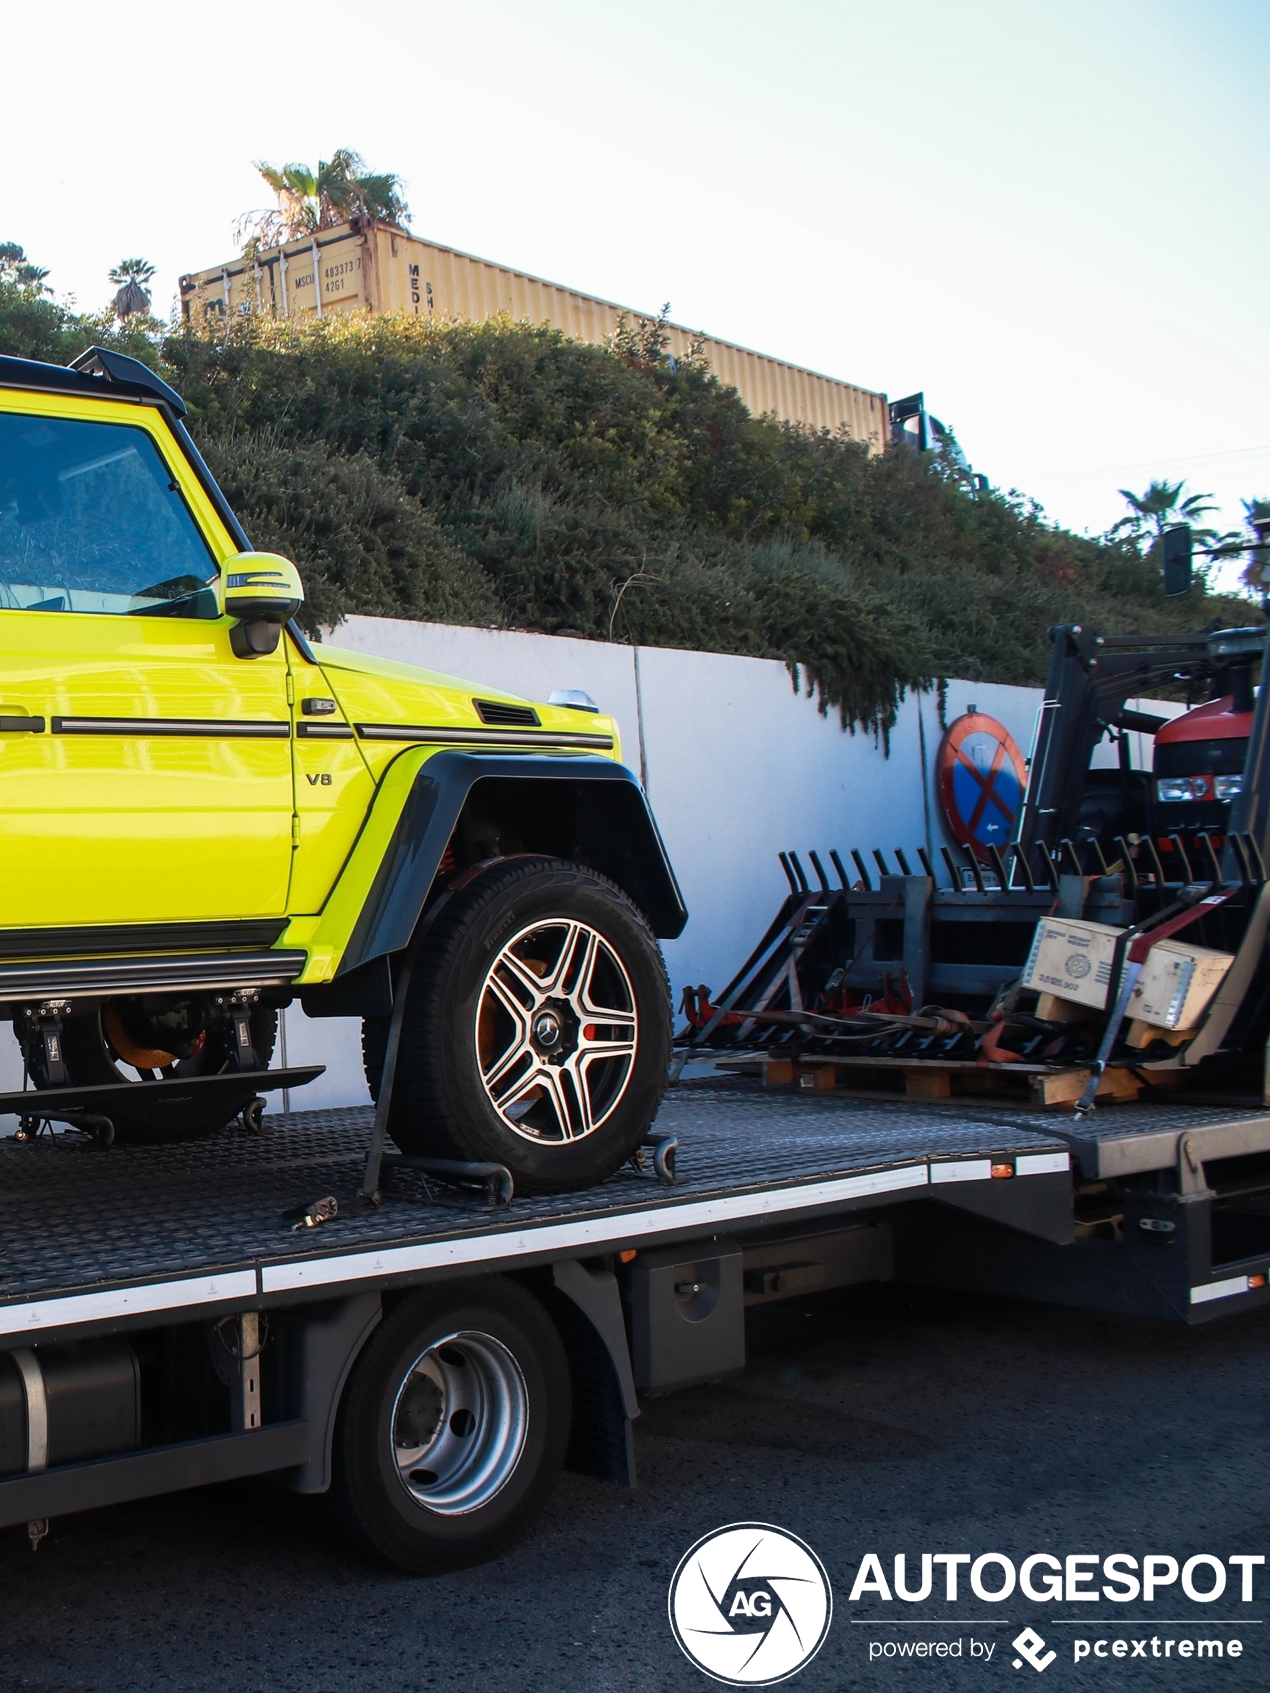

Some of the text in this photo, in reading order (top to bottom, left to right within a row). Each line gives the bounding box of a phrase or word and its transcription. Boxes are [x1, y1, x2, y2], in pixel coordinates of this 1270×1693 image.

[295, 273, 314, 289] MSCU
[324, 260, 354, 279] 483373
[325, 278, 345, 293] 42G1
[305, 773, 333, 786] V8
